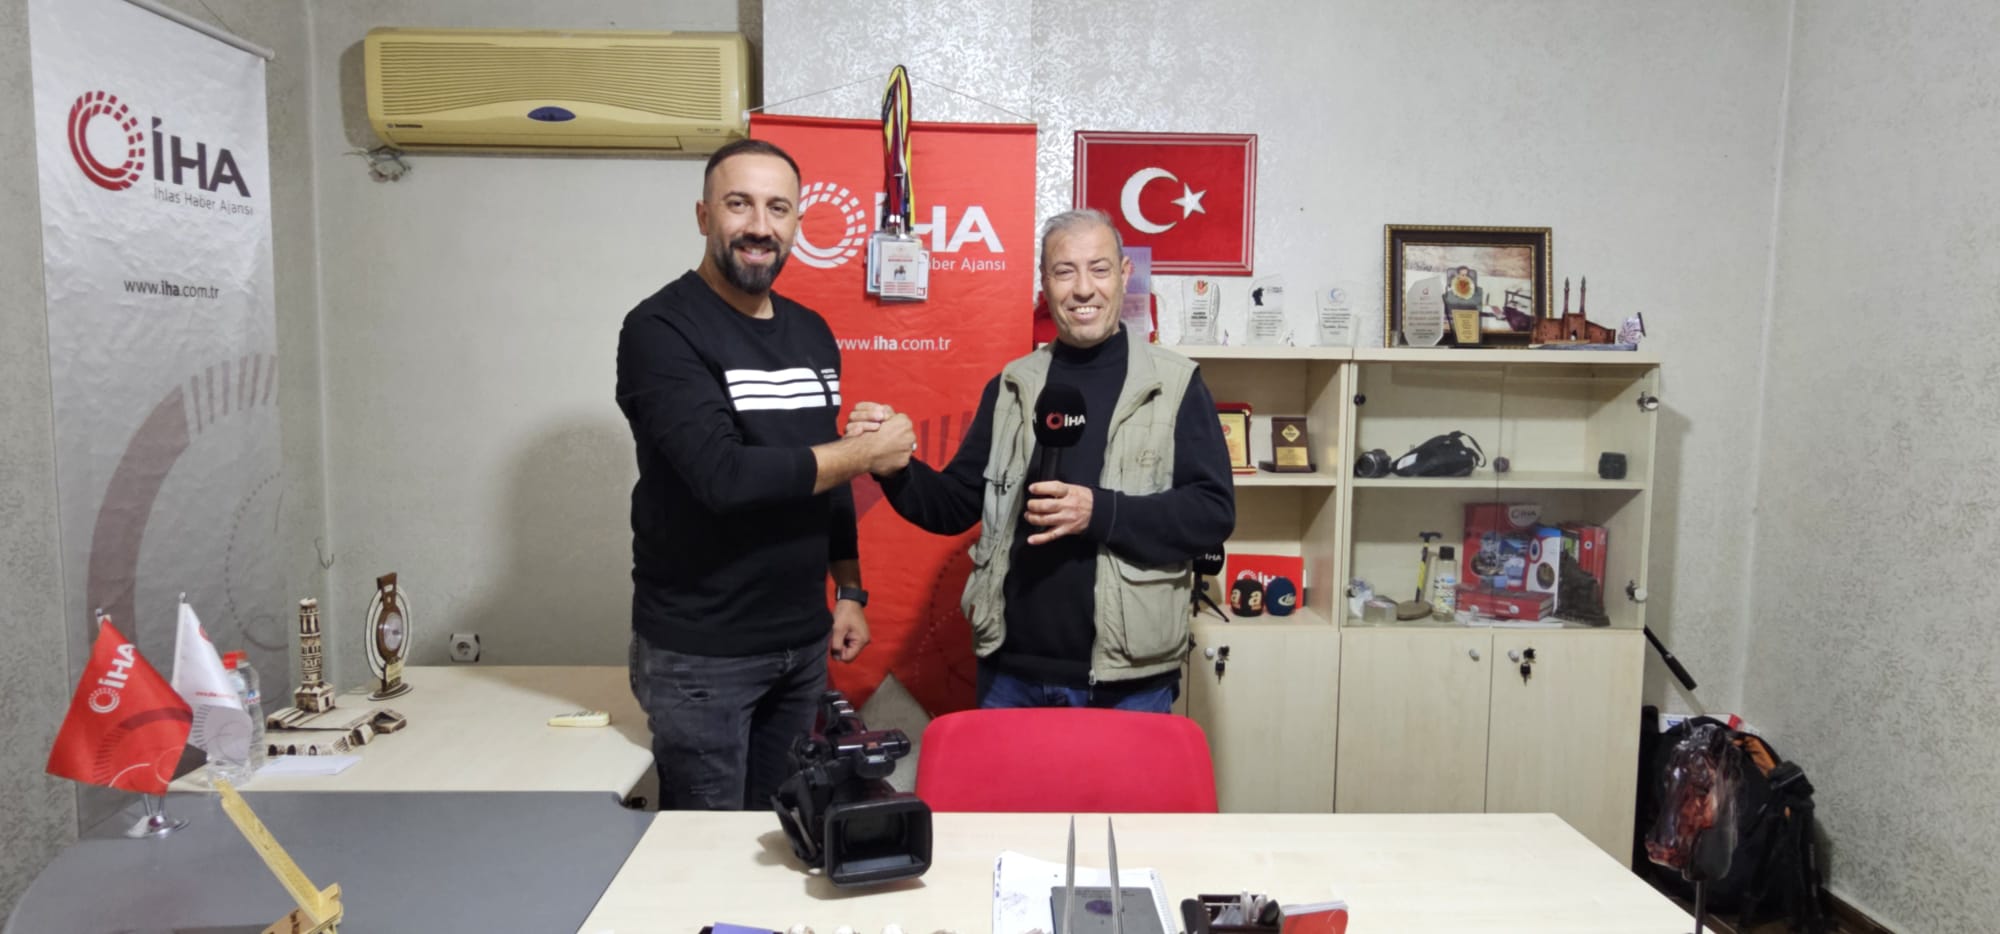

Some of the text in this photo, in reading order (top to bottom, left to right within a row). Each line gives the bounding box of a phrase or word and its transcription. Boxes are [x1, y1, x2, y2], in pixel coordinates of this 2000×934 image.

[152, 116, 252, 198] İHA
[184, 191, 216, 210] Haber
[220, 199, 254, 216] Ajansı
[961, 257, 1006, 273] Ajansı
[123, 279, 220, 299] www.iha.com.tr
